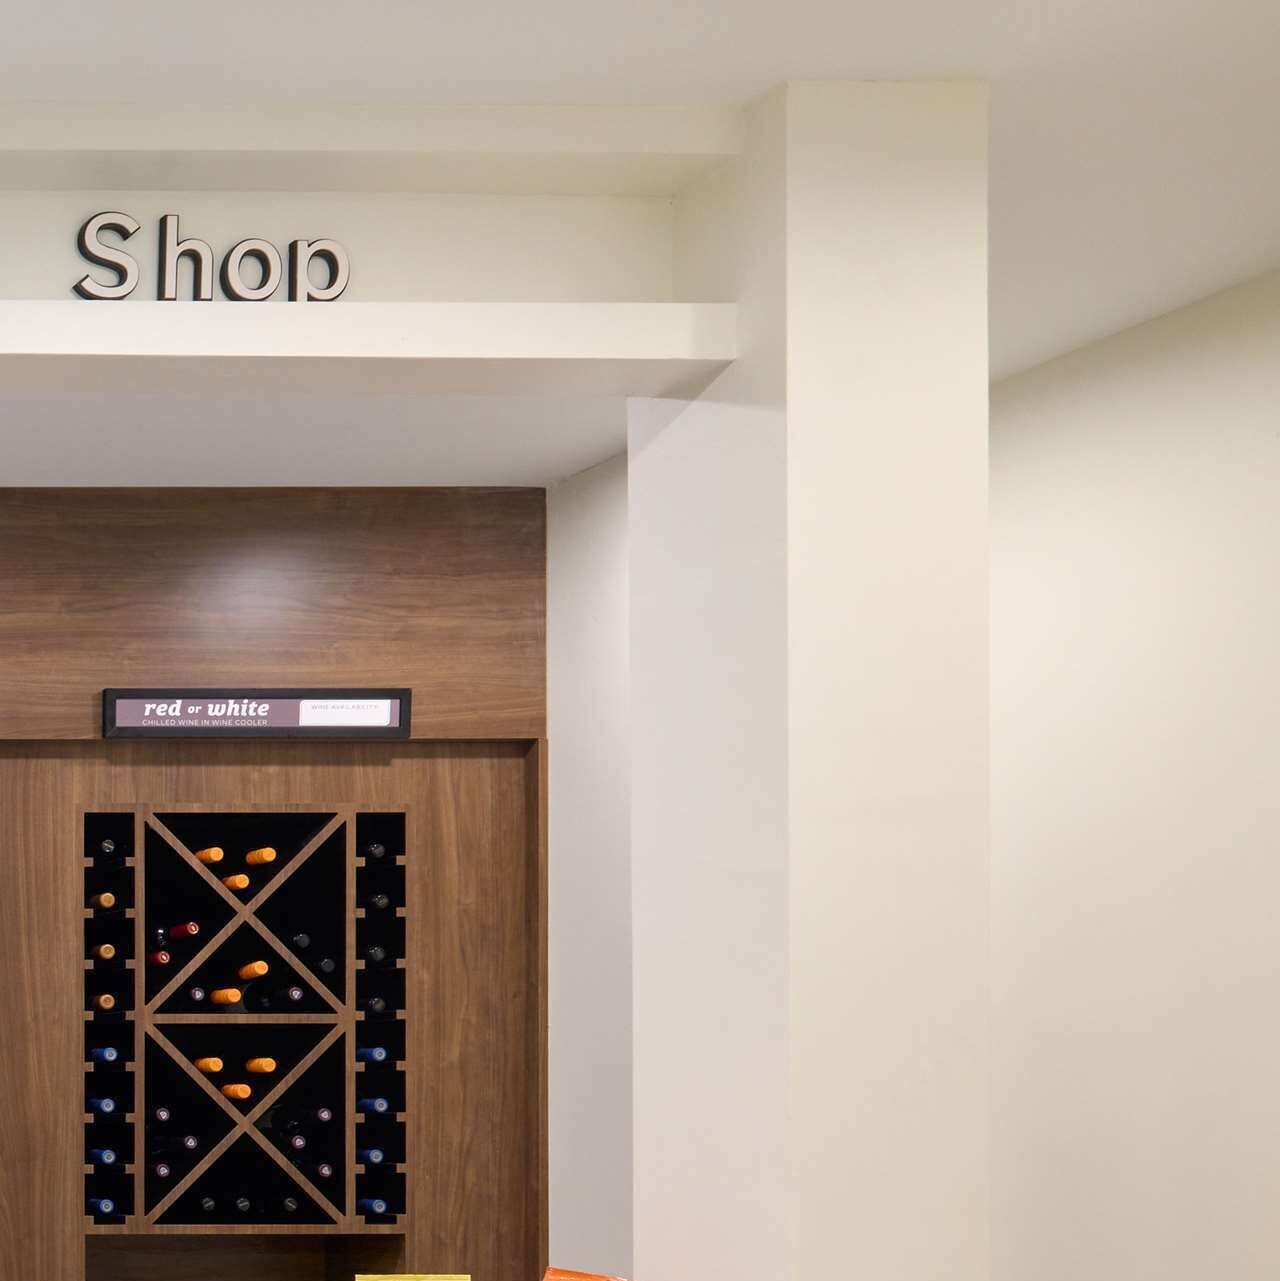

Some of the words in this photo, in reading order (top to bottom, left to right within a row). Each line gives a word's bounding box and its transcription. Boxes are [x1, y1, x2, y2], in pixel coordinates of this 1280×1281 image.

[72, 211, 351, 301] Shop
[144, 699, 181, 716] red
[187, 704, 202, 714] or
[207, 699, 269, 716] white
[142, 719, 176, 727] CHILLED
[177, 719, 199, 727] WINE
[201, 719, 209, 727] IN
[211, 719, 234, 727] WINE
[235, 719, 268, 727] COOLER
